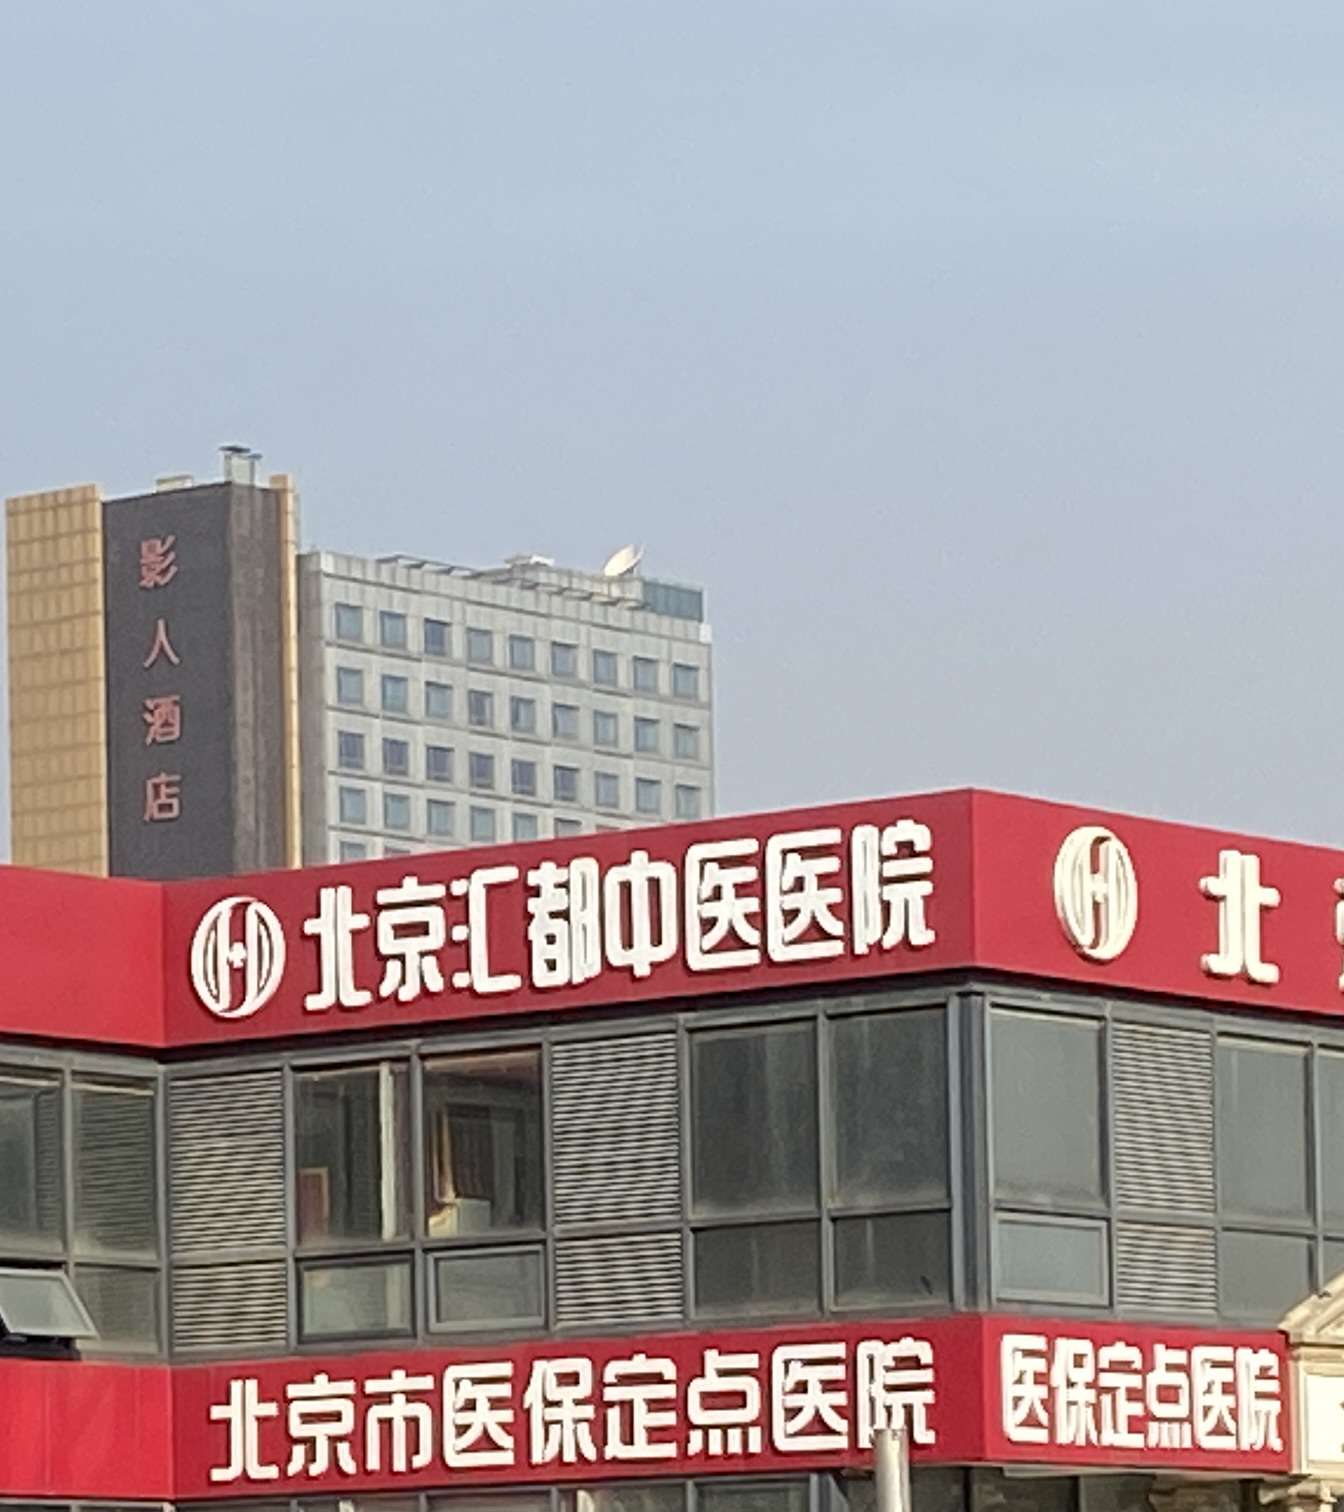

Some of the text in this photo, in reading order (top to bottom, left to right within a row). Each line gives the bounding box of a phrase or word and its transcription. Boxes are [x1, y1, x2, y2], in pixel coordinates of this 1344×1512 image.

[138, 534, 182, 823] 影人酒店
[302, 819, 935, 1012] 北京汇都中医医院
[211, 1338, 935, 1483] 北京市医保定点医院
[1001, 1333, 1284, 1452] 医保定点医院
